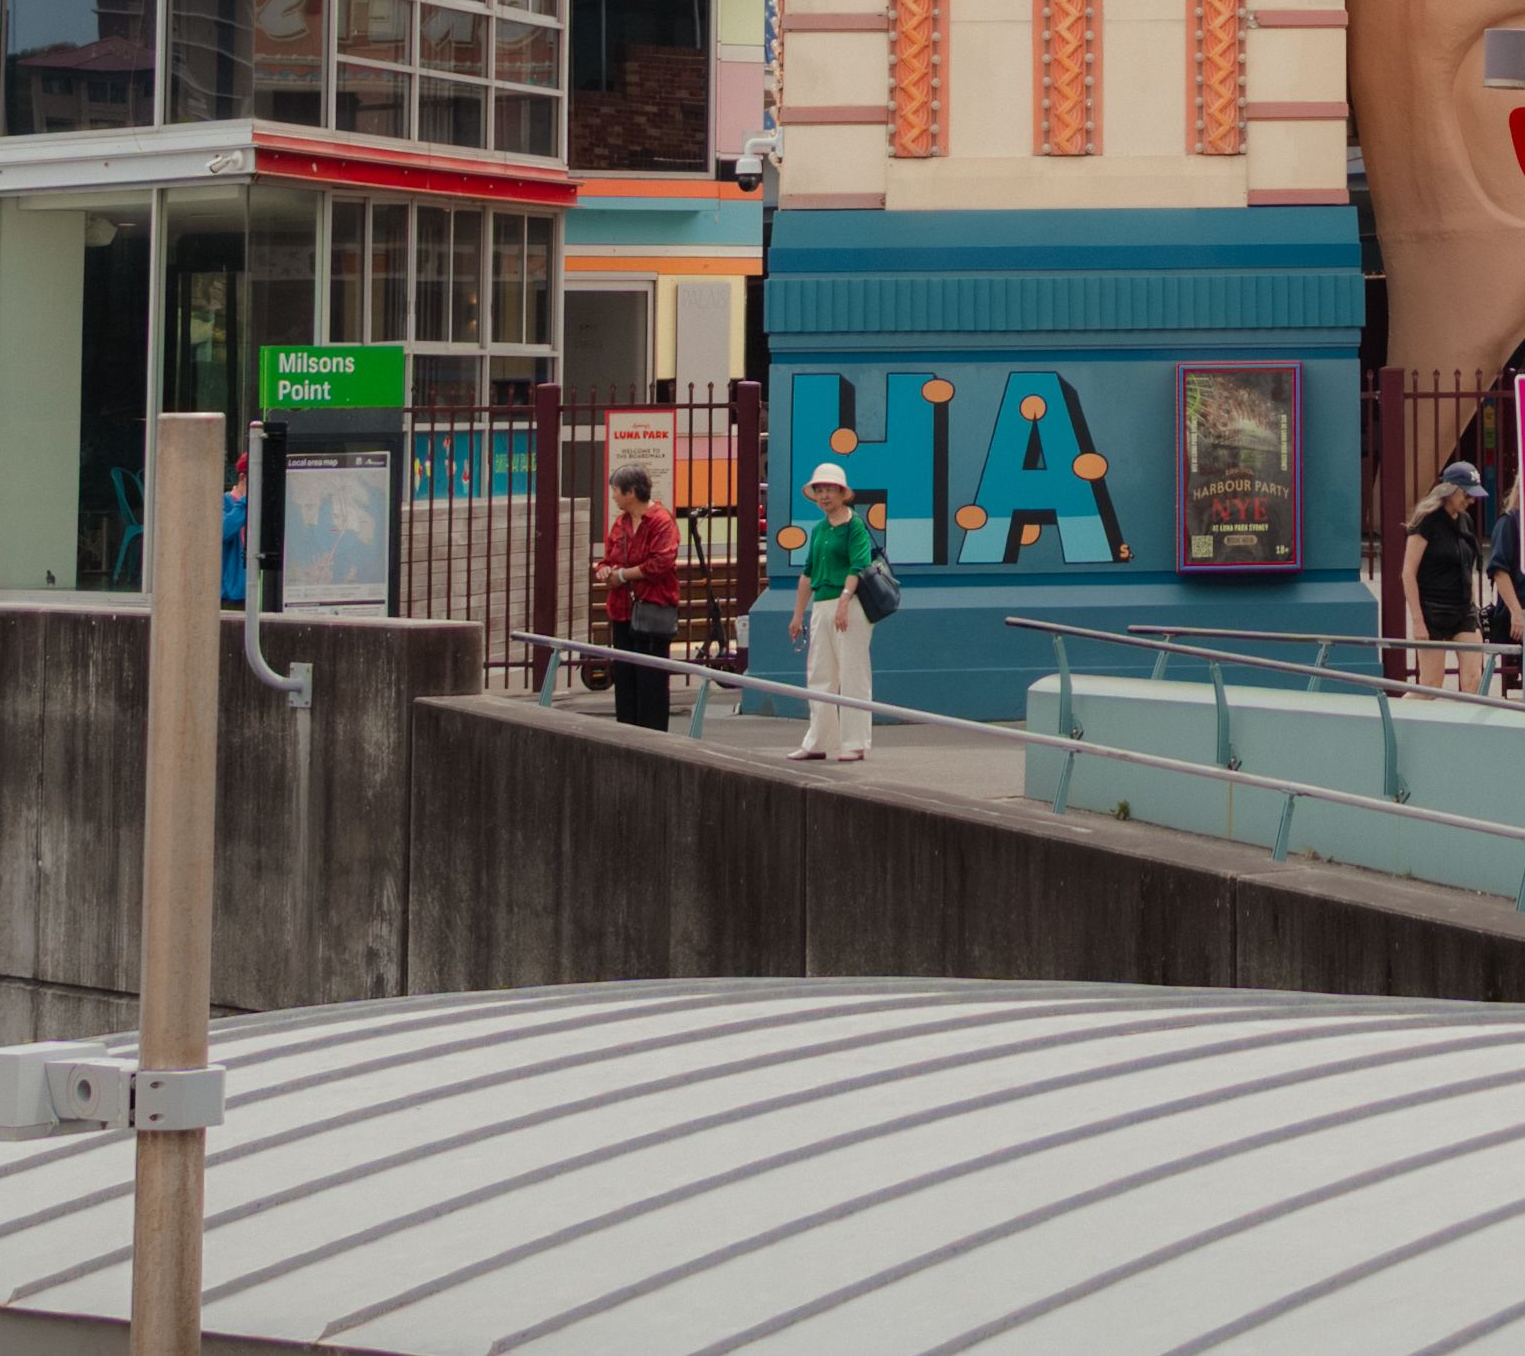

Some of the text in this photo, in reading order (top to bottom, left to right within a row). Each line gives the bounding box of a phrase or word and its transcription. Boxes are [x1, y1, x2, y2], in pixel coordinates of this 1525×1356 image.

[278, 352, 355, 374] Milsons
[278, 380, 331, 400] Point
[614, 431, 668, 439] LUNA PARK
[288, 457, 306, 467] Local
[323, 459, 338, 467] map
[789, 372, 1129, 565] HA
[1193, 479, 1289, 501] HARBOUR PARTY
[1211, 497, 1268, 522] NYE
[1249, 523, 1269, 531] SYDNEY
[1276, 544, 1289, 554] 18+
